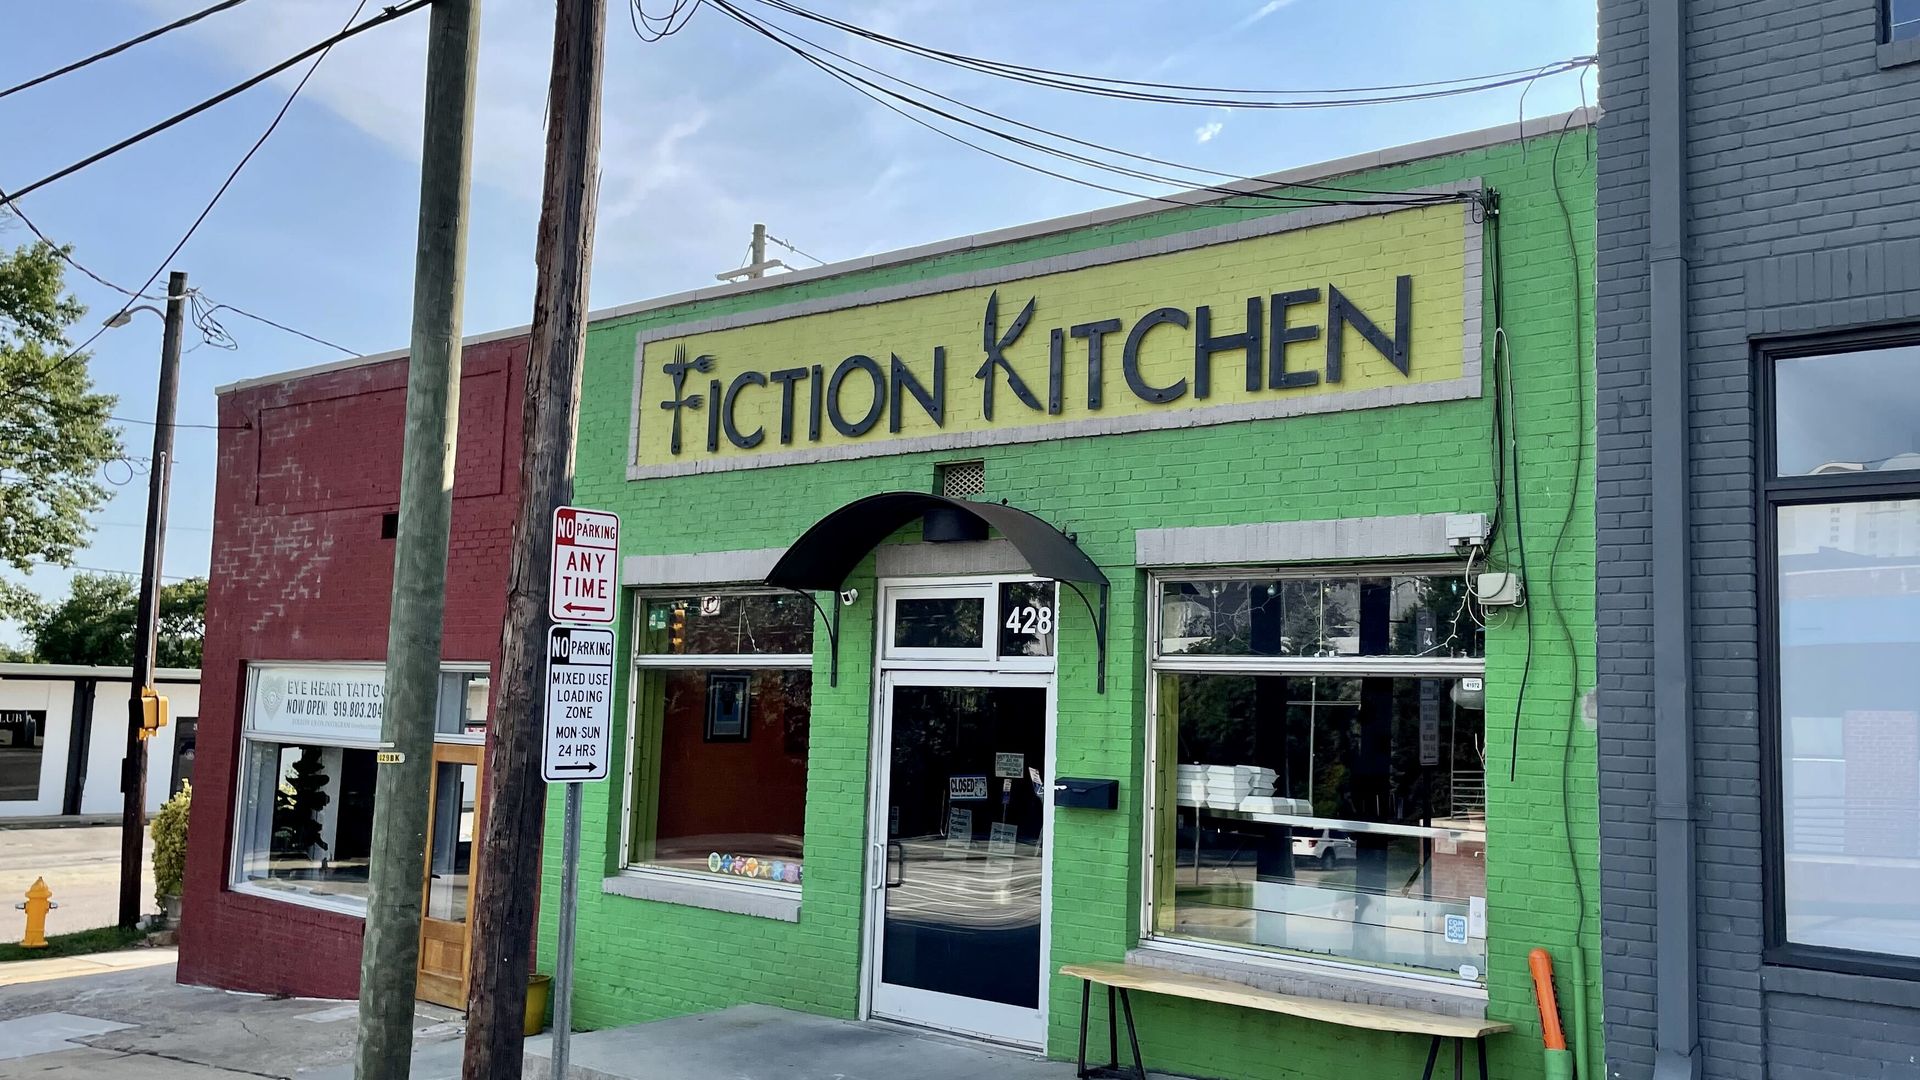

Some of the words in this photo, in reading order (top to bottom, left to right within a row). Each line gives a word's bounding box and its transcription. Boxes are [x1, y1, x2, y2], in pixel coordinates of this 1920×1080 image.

[661, 342, 945, 455] FICTION
[974, 275, 1412, 421] KITCHEN
[557, 517, 574, 537] NO
[576, 522, 616, 540] PARKING
[566, 551, 606, 574] ANY
[562, 576, 608, 599] TIME
[1006, 606, 1051, 635] 428
[552, 636, 569, 658] NO
[571, 640, 611, 656] PARKING
[552, 673, 585, 686] MIXED
[588, 673, 609, 686] USE
[287, 680, 307, 695] EYE
[310, 680, 343, 697] HEART
[557, 690, 603, 703] LOADING
[286, 699, 305, 714] NOW
[565, 706, 593, 719] ZONE
[555, 726, 600, 739] MON-SUN
[558, 744, 572, 756] 24
[575, 744, 596, 757] HRS
[951, 778, 974, 792] CLOSED
